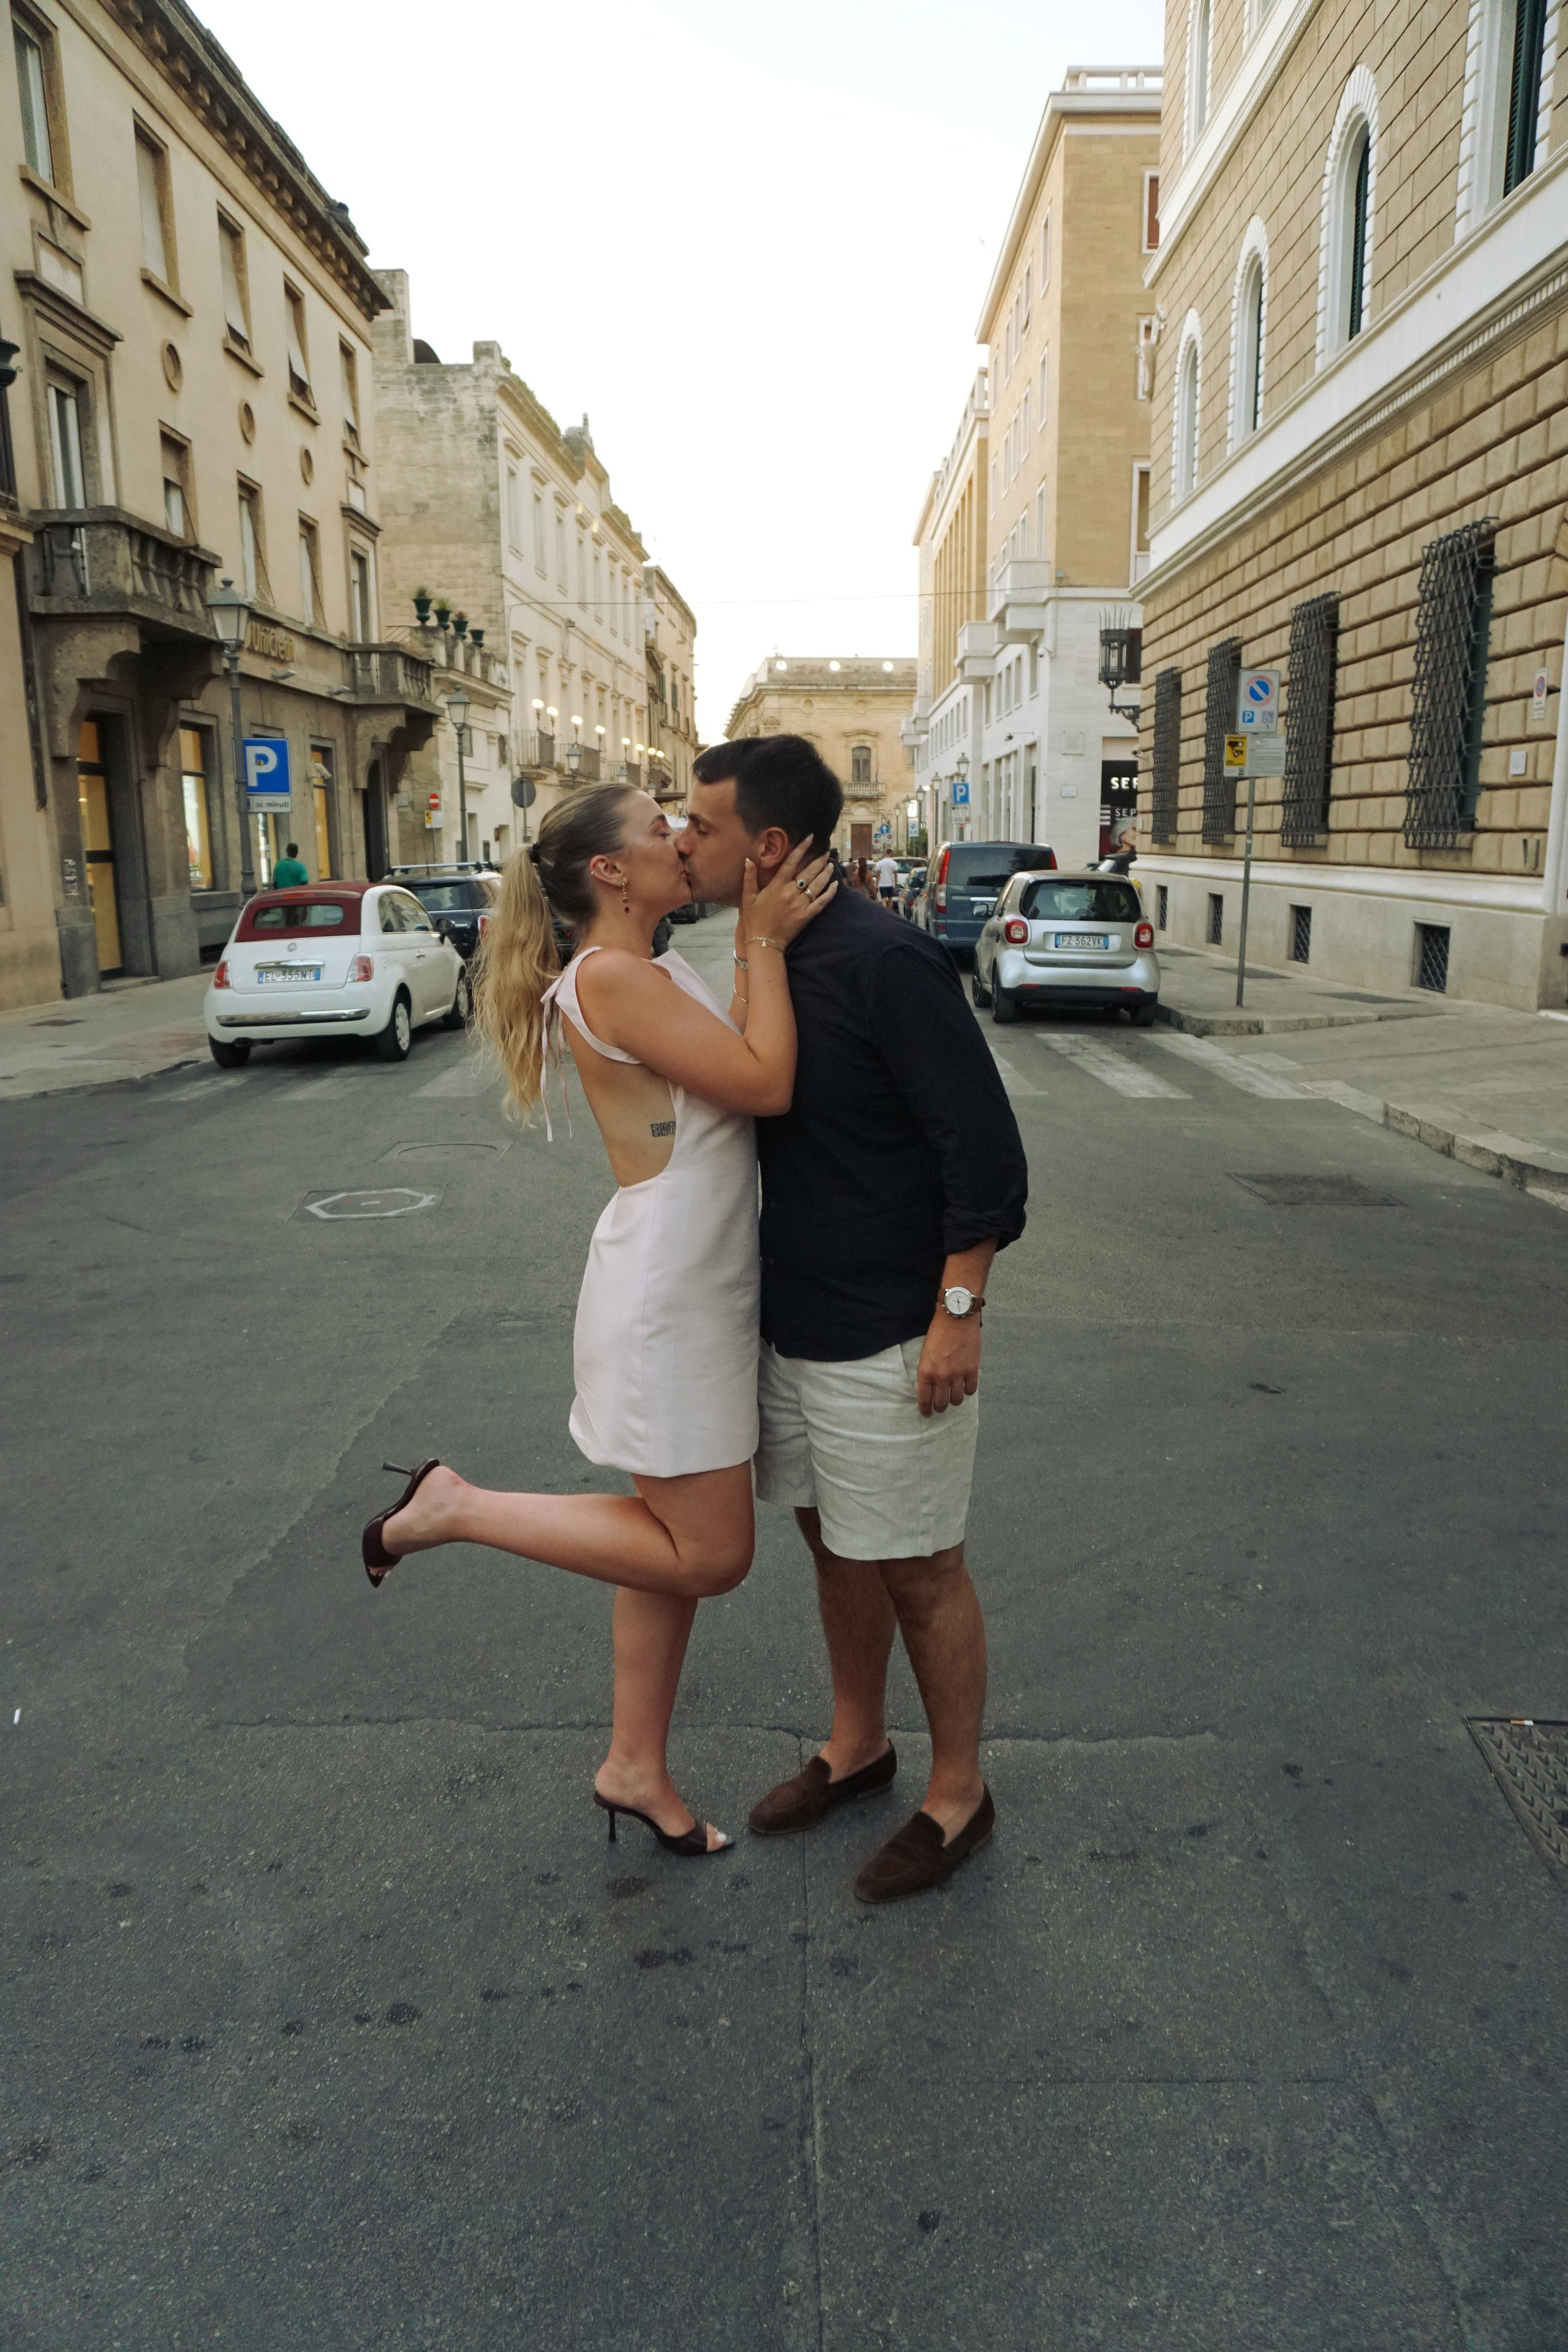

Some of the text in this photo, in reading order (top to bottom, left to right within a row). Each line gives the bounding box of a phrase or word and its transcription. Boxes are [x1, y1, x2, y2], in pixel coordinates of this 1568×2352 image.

[1245, 712, 1253, 722] P
[246, 745, 277, 786] P
[956, 785, 967, 802] P
[266, 799, 289, 808] minuti
